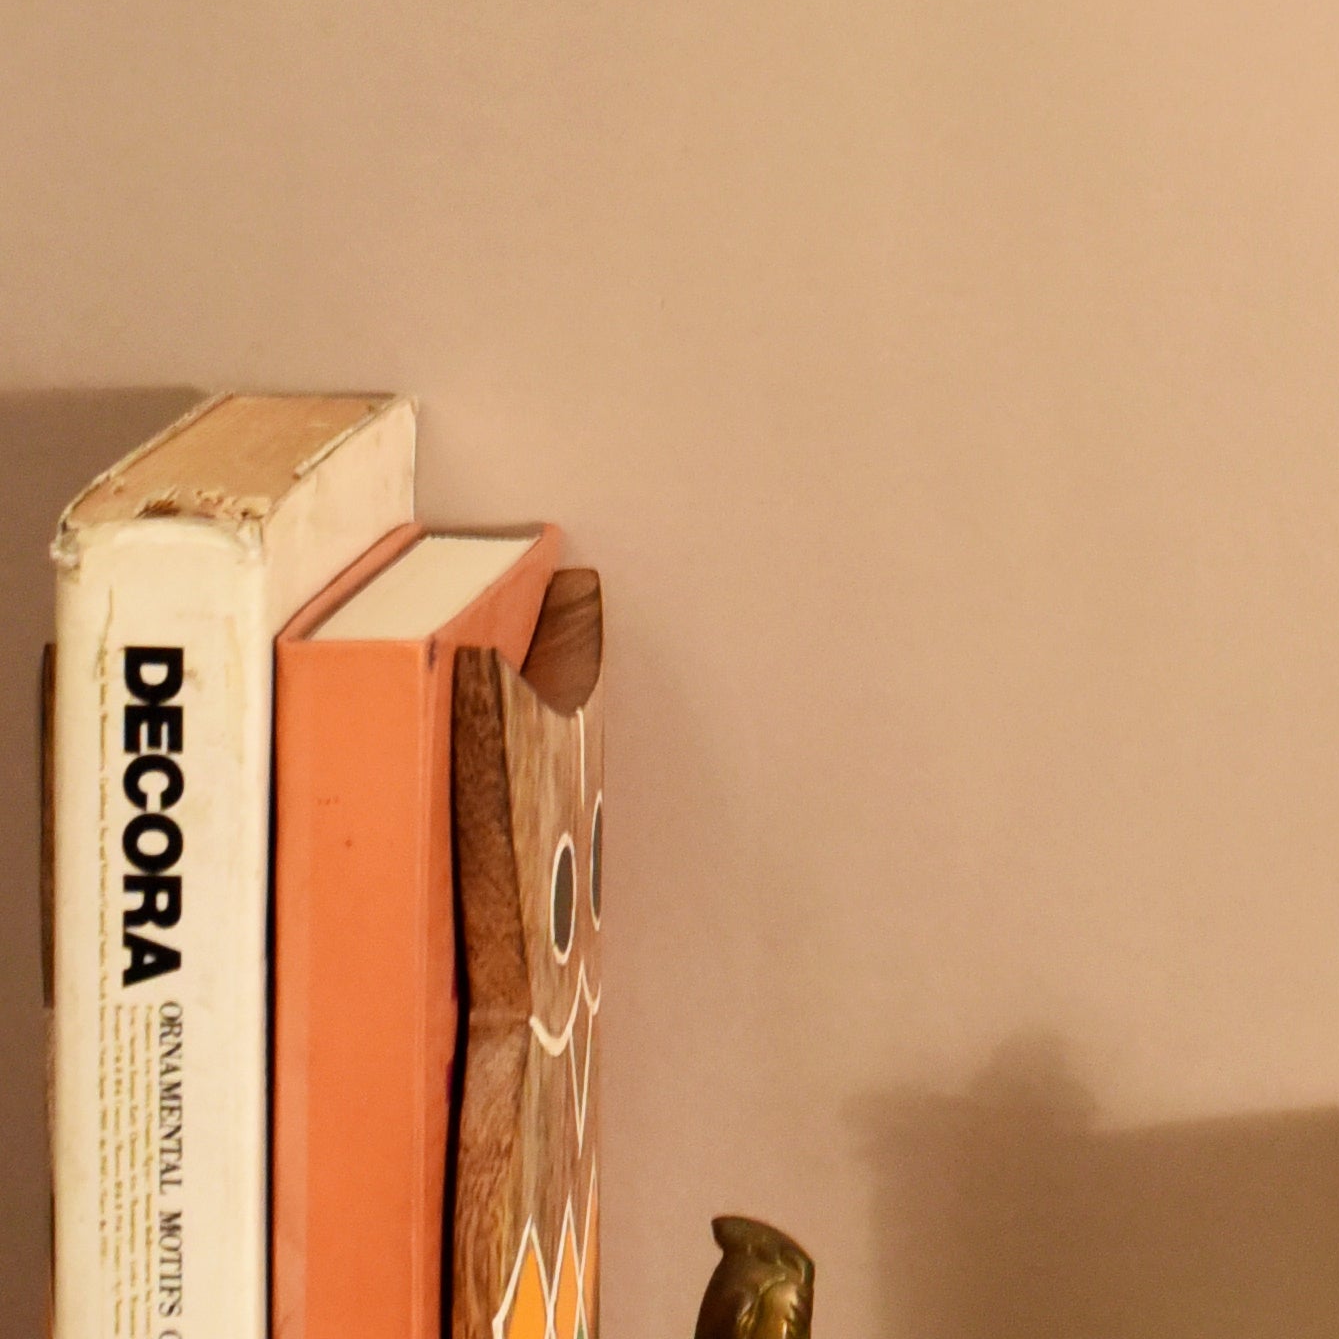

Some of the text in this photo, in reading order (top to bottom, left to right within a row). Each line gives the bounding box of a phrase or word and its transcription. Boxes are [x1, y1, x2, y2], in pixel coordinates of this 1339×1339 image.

[121, 646, 184, 988] DECORA
[157, 1002, 183, 1195] ORNAMENTAL
[157, 1211, 183, 1317] MOTIFS
